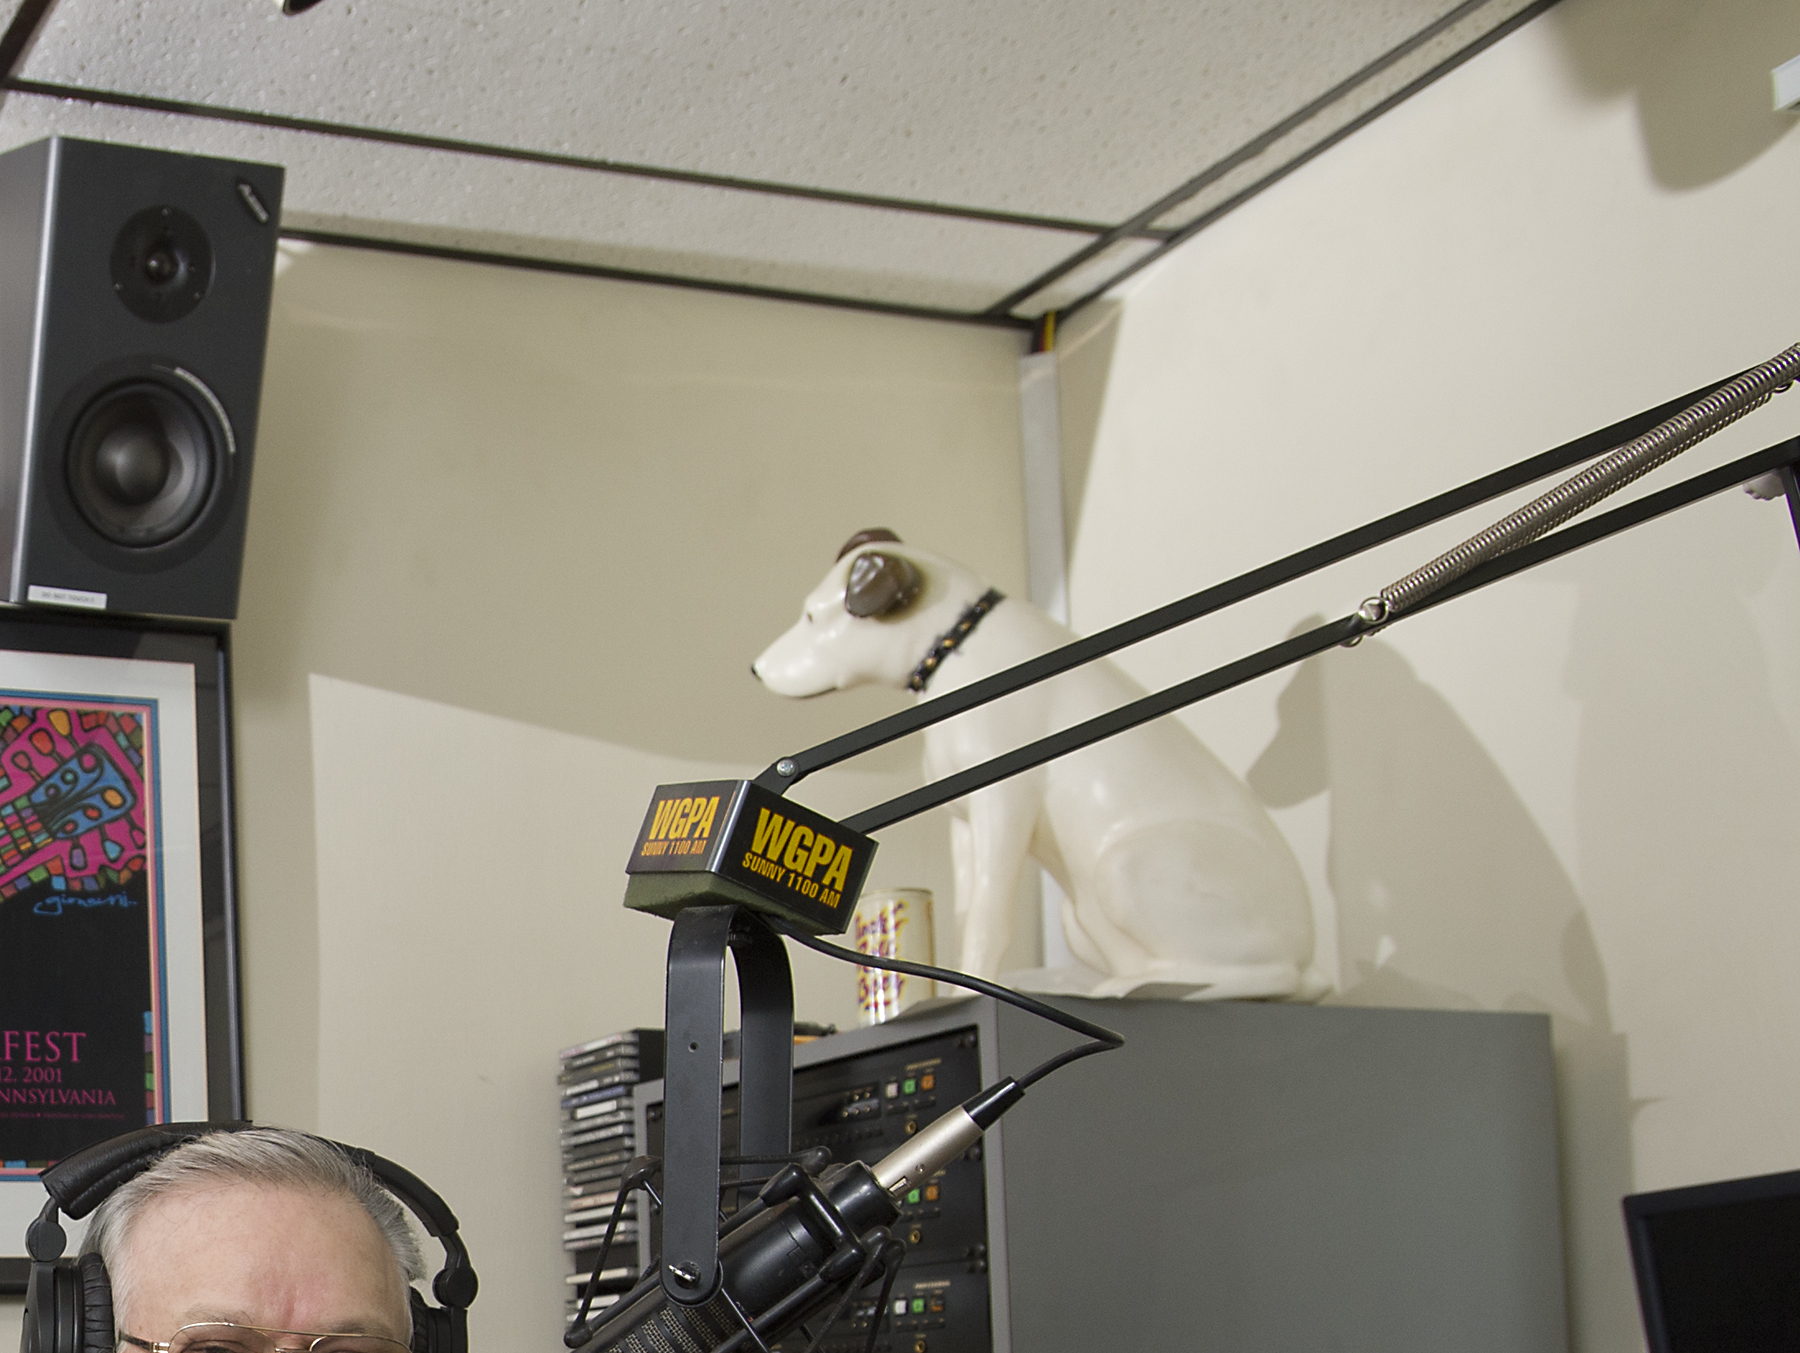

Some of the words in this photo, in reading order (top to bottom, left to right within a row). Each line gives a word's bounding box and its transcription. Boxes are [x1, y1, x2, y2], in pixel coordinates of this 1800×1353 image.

[649, 796, 720, 840] WGPA
[641, 841, 669, 856] SUNNY
[669, 840, 691, 855] 1100
[690, 840, 707, 855] AM
[751, 807, 853, 893] WGPA
[742, 852, 787, 882] SUNNY
[788, 872, 819, 898] 1100
[819, 888, 841, 909] AM
[23, 1067, 63, 1083] 2001
